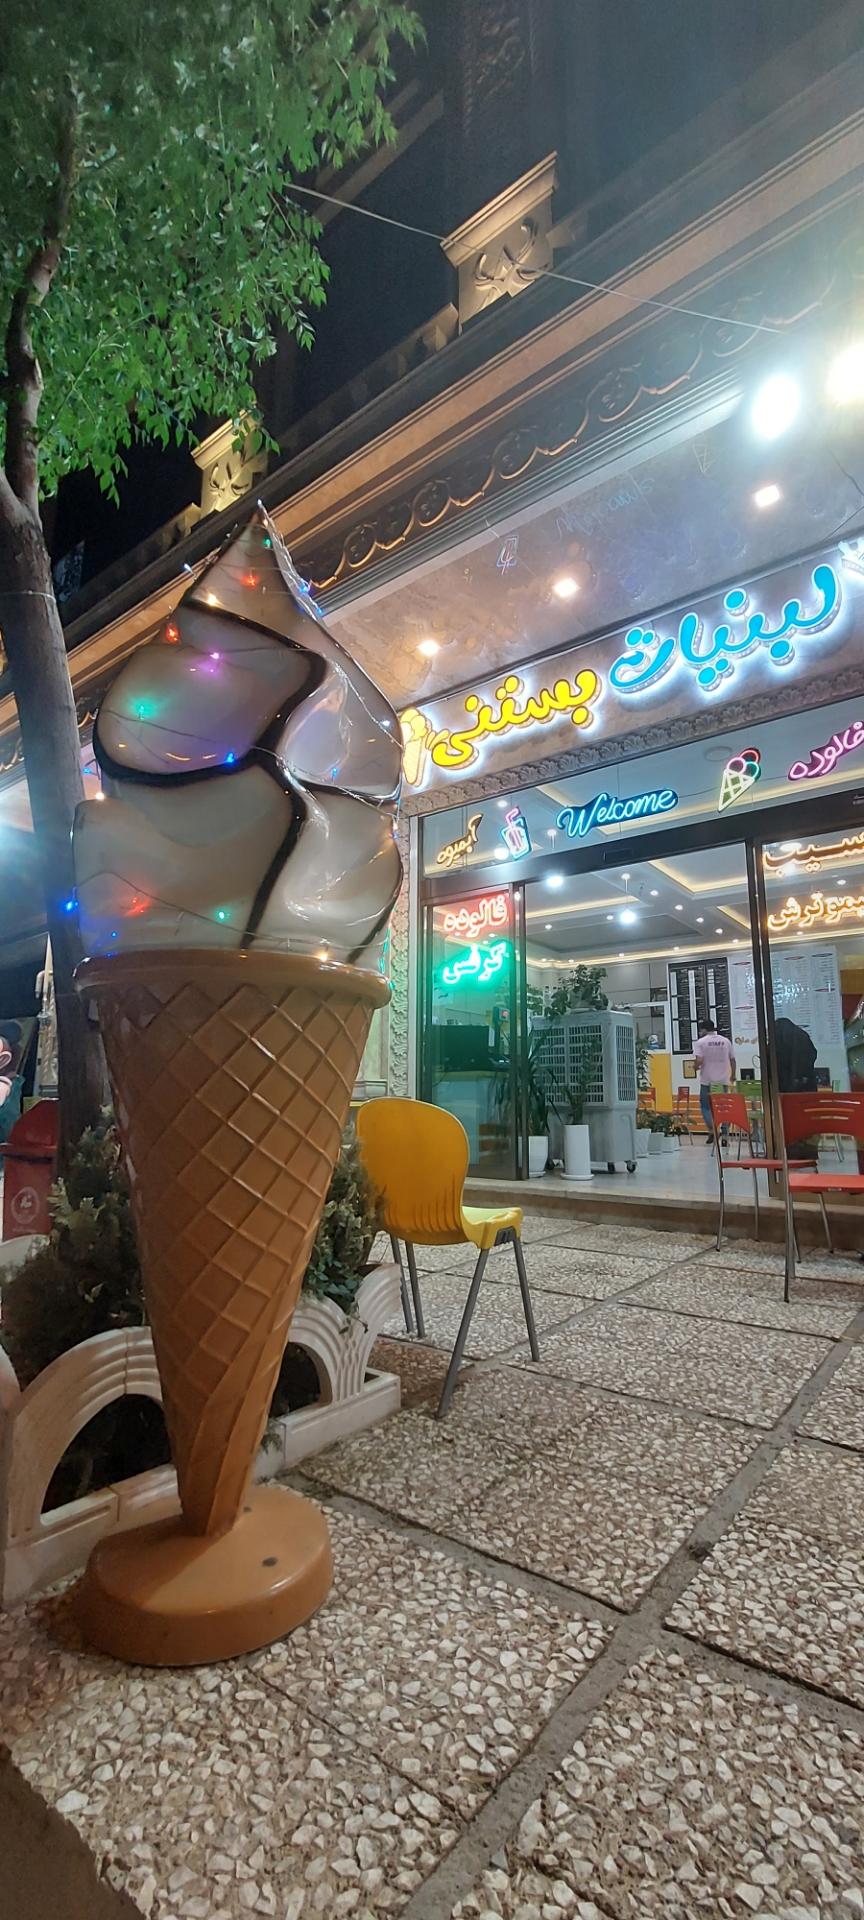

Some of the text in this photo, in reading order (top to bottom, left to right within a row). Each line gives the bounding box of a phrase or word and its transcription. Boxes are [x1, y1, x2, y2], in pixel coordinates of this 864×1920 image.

[431, 564, 840, 767] لبنیات بستنی
[557, 789, 677, 838] Welcome
[436, 813, 484, 866] آبمیوه
[443, 894, 508, 937] فالوده
[442, 942, 507, 985] کرفس
